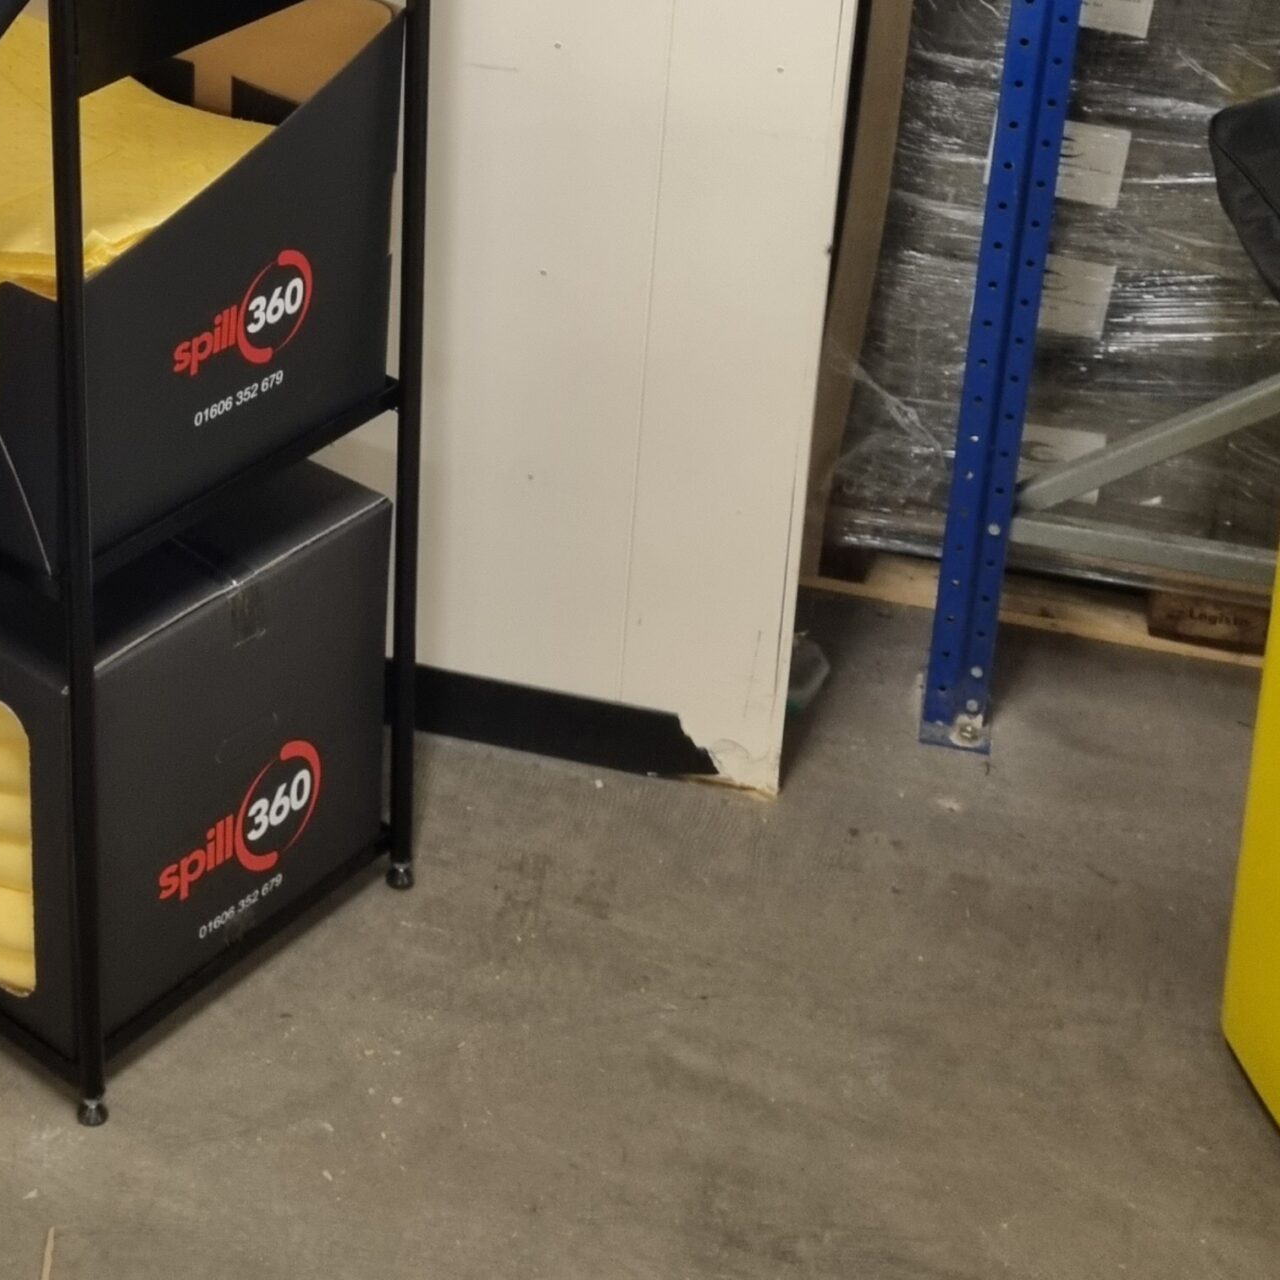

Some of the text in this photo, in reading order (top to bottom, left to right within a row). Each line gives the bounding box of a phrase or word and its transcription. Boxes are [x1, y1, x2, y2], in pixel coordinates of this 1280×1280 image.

[173, 276, 305, 377] spill360
[193, 369, 284, 427] 01606 352 679
[158, 768, 312, 901] spill360
[198, 872, 284, 940] 01606 352 679
